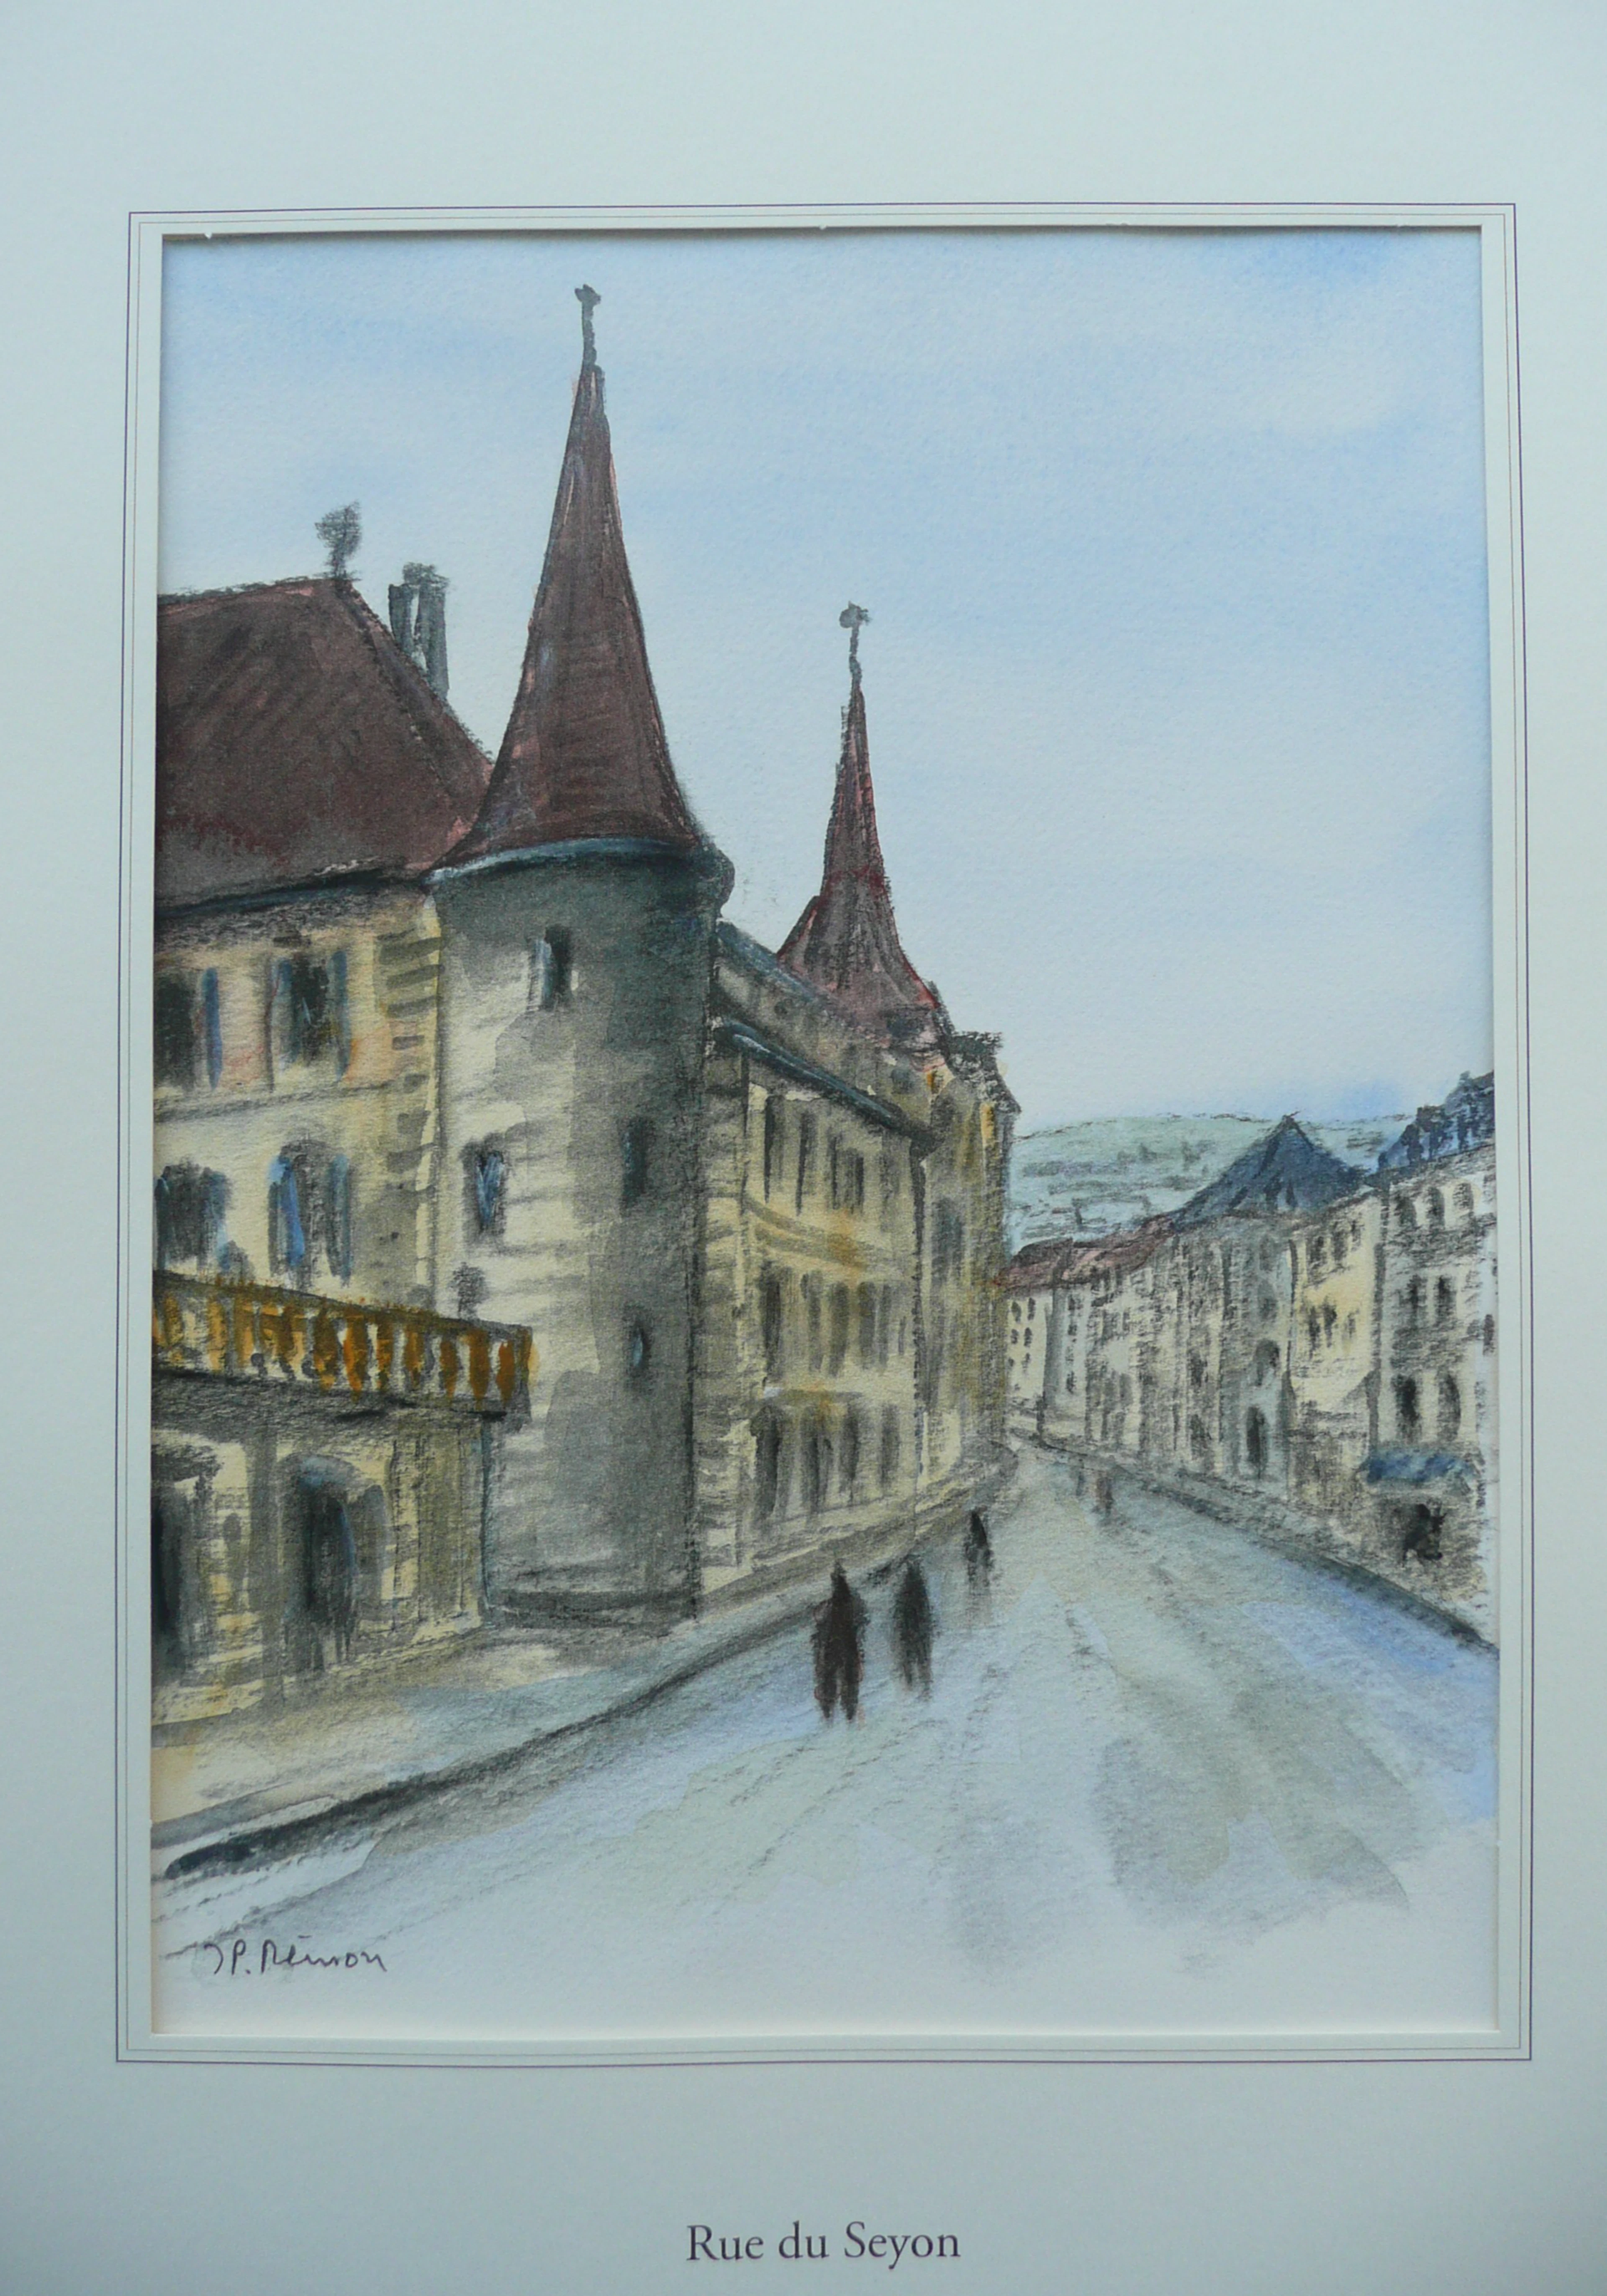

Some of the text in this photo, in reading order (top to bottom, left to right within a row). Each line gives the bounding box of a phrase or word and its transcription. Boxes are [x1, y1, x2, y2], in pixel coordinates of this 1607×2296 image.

[686, 2220, 962, 2270] Rue du Seyon
